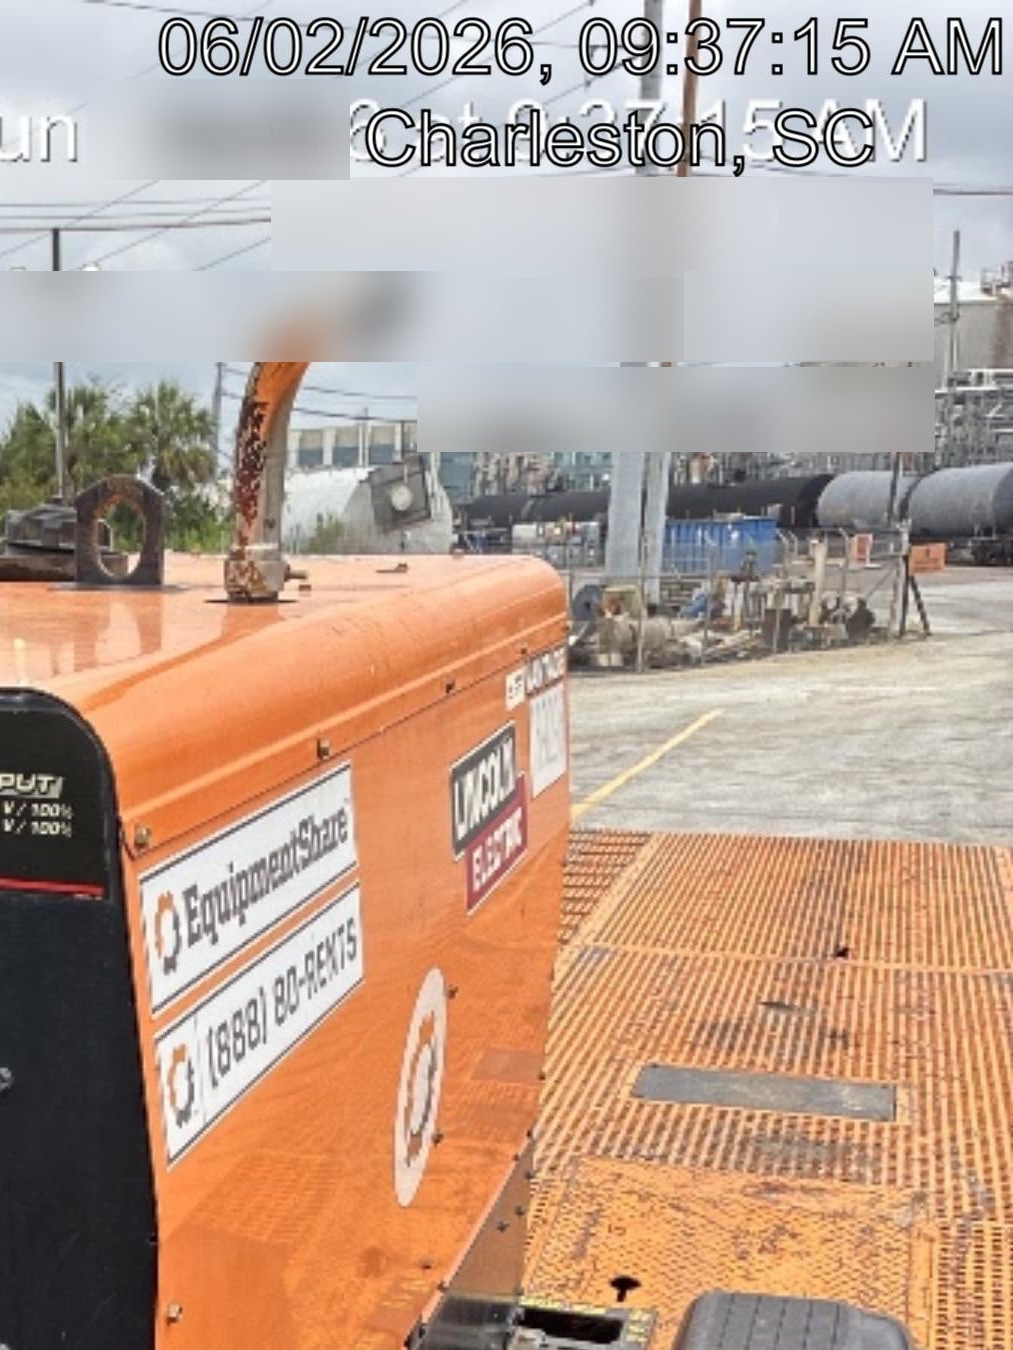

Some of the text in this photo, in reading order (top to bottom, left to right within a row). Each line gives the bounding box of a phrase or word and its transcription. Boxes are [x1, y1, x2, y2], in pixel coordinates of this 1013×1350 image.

[454, 736, 514, 841] LINCOLN
[183, 806, 349, 946] EquipmentShare
[206, 917, 358, 1089] (888) 80-RENTS
